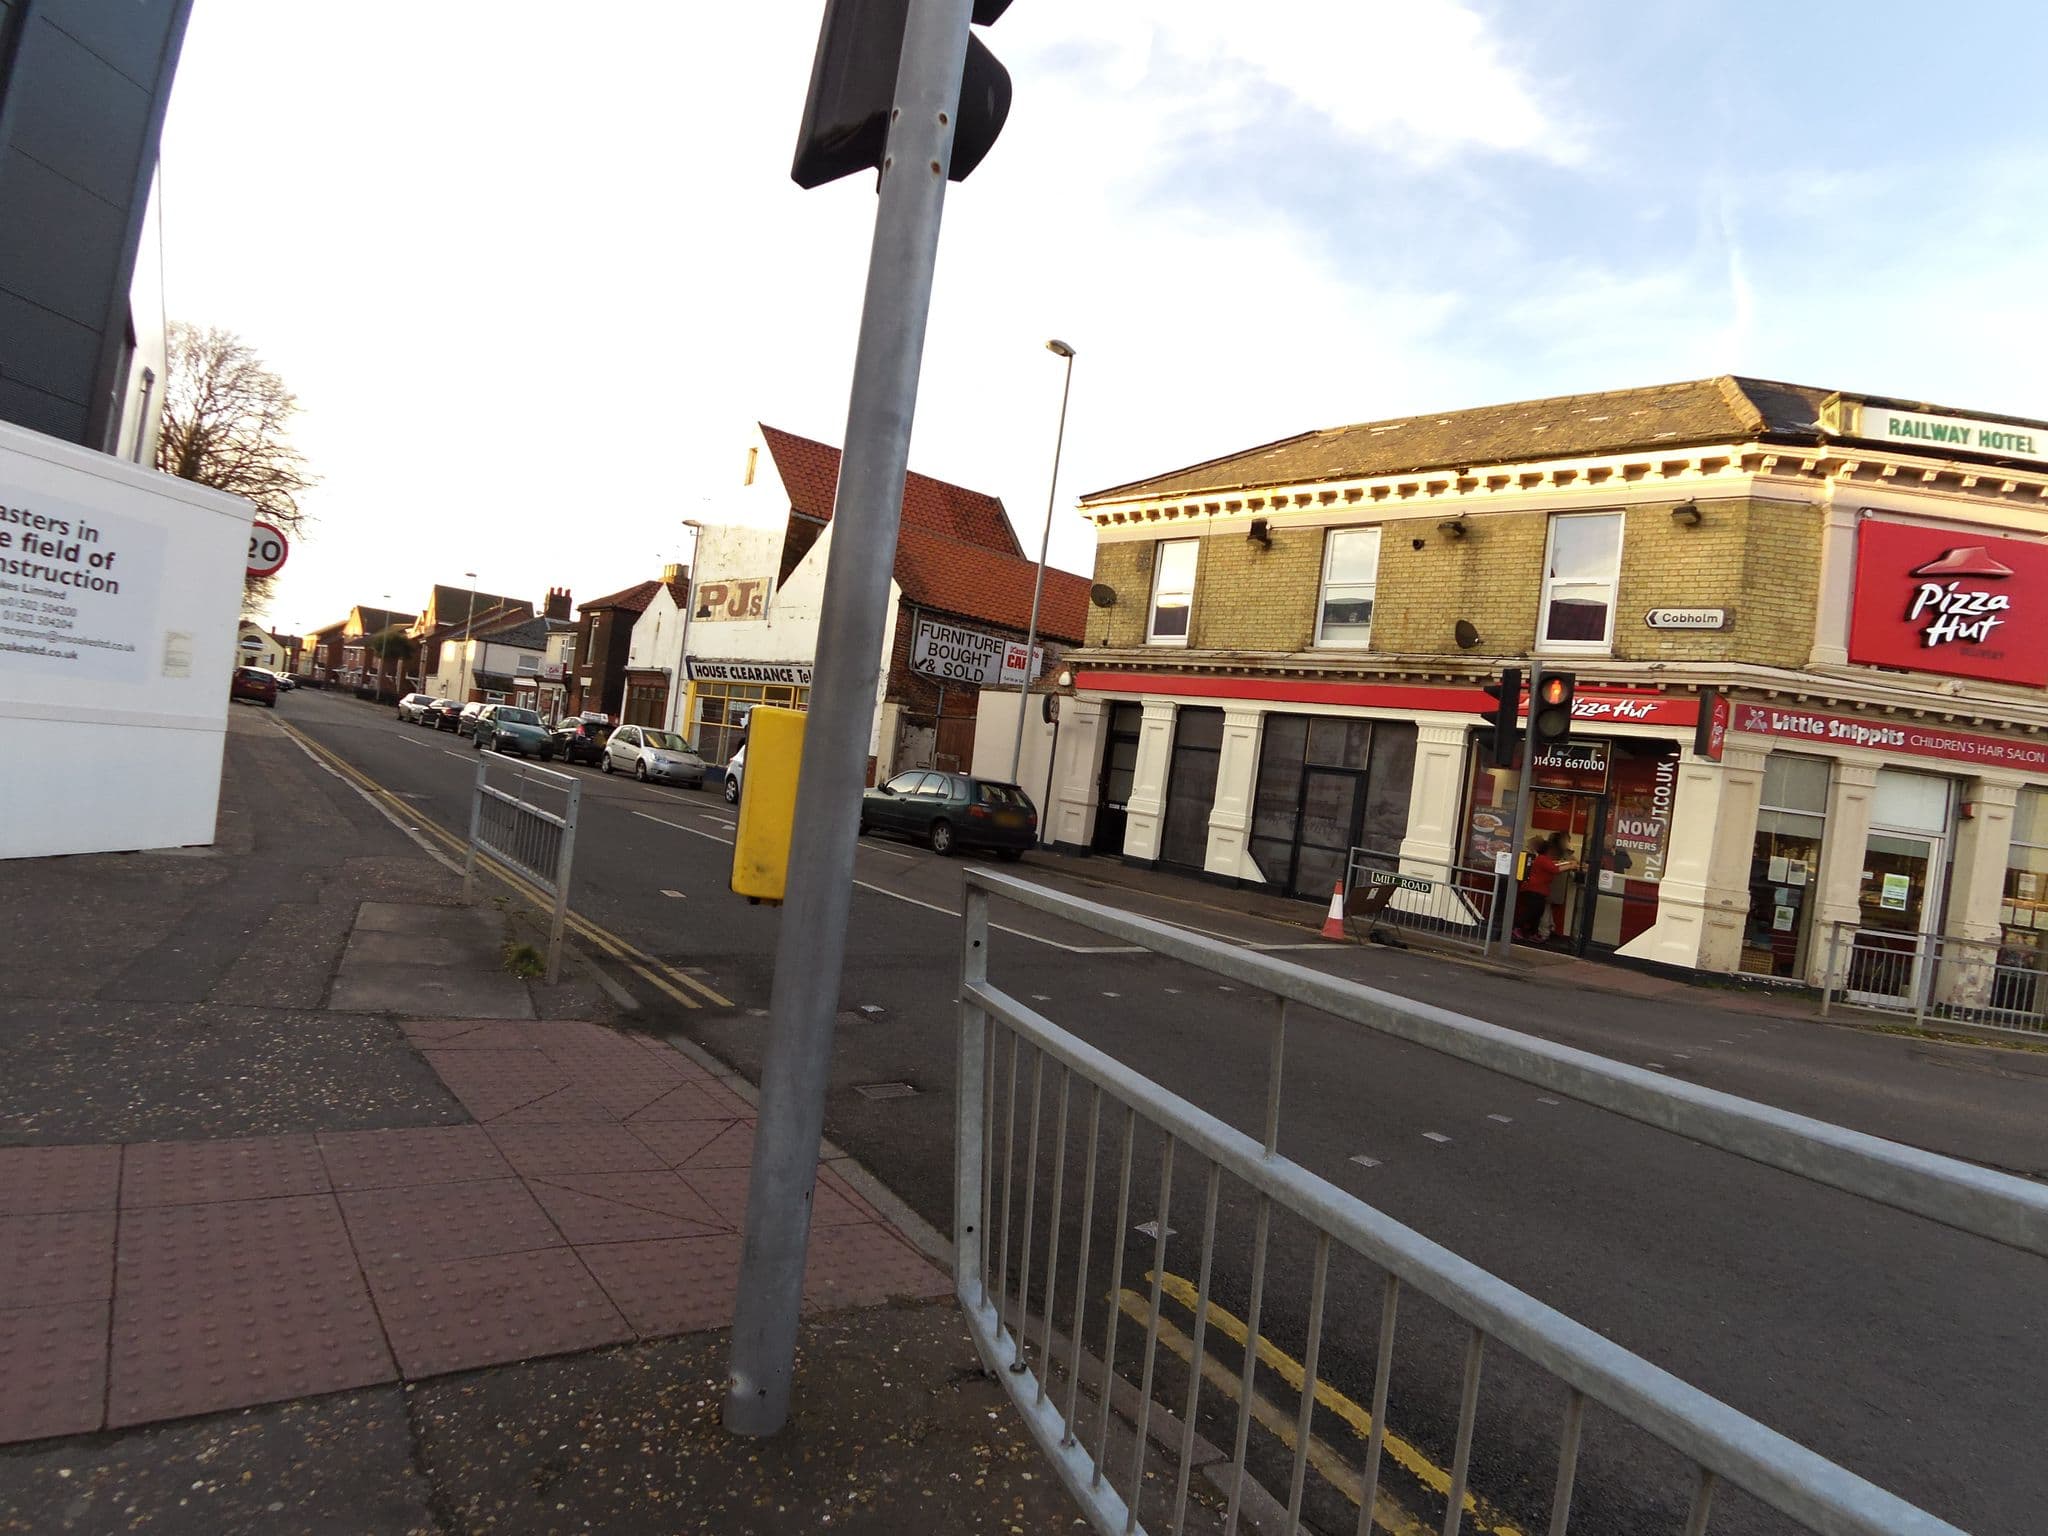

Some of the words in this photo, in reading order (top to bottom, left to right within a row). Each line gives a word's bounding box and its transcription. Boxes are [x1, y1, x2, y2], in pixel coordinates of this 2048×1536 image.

[1889, 417, 1971, 444] RAILWAY
[1978, 429, 2037, 454] HOTEL
[78, 519, 99, 543] in
[21, 532, 81, 563] field
[88, 551, 116, 570] of
[22, 583, 66, 599] Limited
[1910, 581, 2010, 620] Pizza
[1662, 613, 1718, 623] Cobholm
[1926, 613, 2005, 647] Hut
[920, 623, 1003, 655] FURNITURE
[928, 642, 992, 668] BOUGHT
[694, 665, 728, 679] HOUSE
[730, 666, 794, 683] CLEARANCE
[925, 658, 936, 674] &
[943, 662, 984, 683] SOLD
[1613, 699, 1658, 719] Hut
[1772, 712, 1825, 735] Little
[1828, 719, 1905, 746] Snippits
[1910, 734, 1975, 754] CHILDREN'S
[1977, 744, 2004, 758] HAIR
[2006, 748, 2046, 763] SALON
[1565, 758, 1605, 771] 667000
[1617, 819, 1661, 838] NOW
[1615, 838, 1657, 851] DRIVERS
[1401, 879, 1430, 892] ROAD
